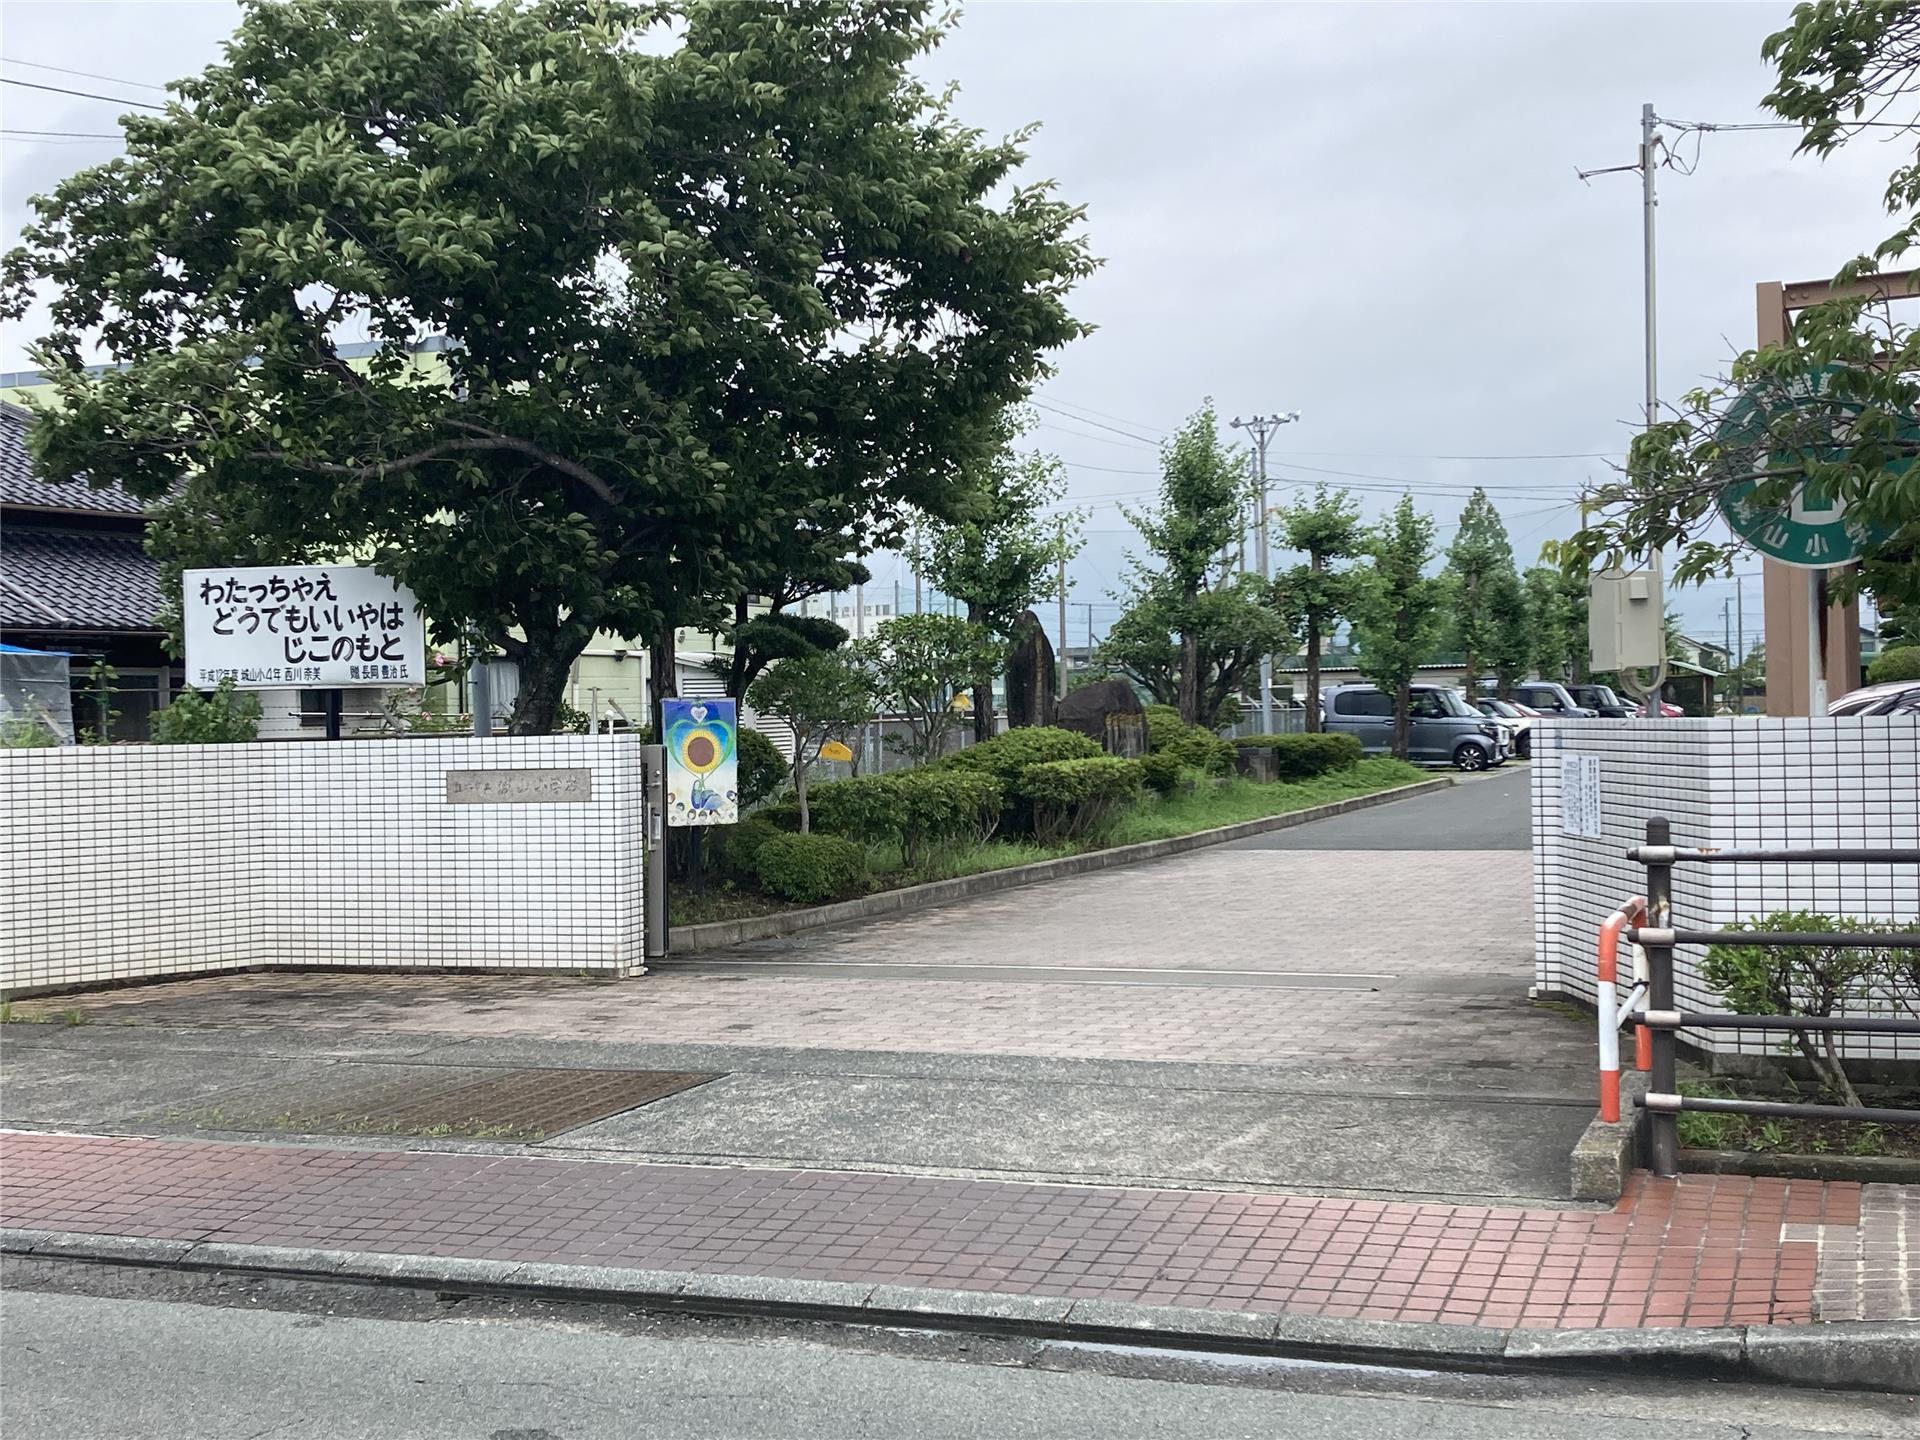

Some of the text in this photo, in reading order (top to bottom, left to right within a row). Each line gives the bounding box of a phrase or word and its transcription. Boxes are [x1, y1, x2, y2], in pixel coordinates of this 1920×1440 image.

[200, 572, 337, 605] わたっちゃえ
[212, 602, 404, 635] どうでもいいやは
[284, 633, 405, 663] じこのもと
